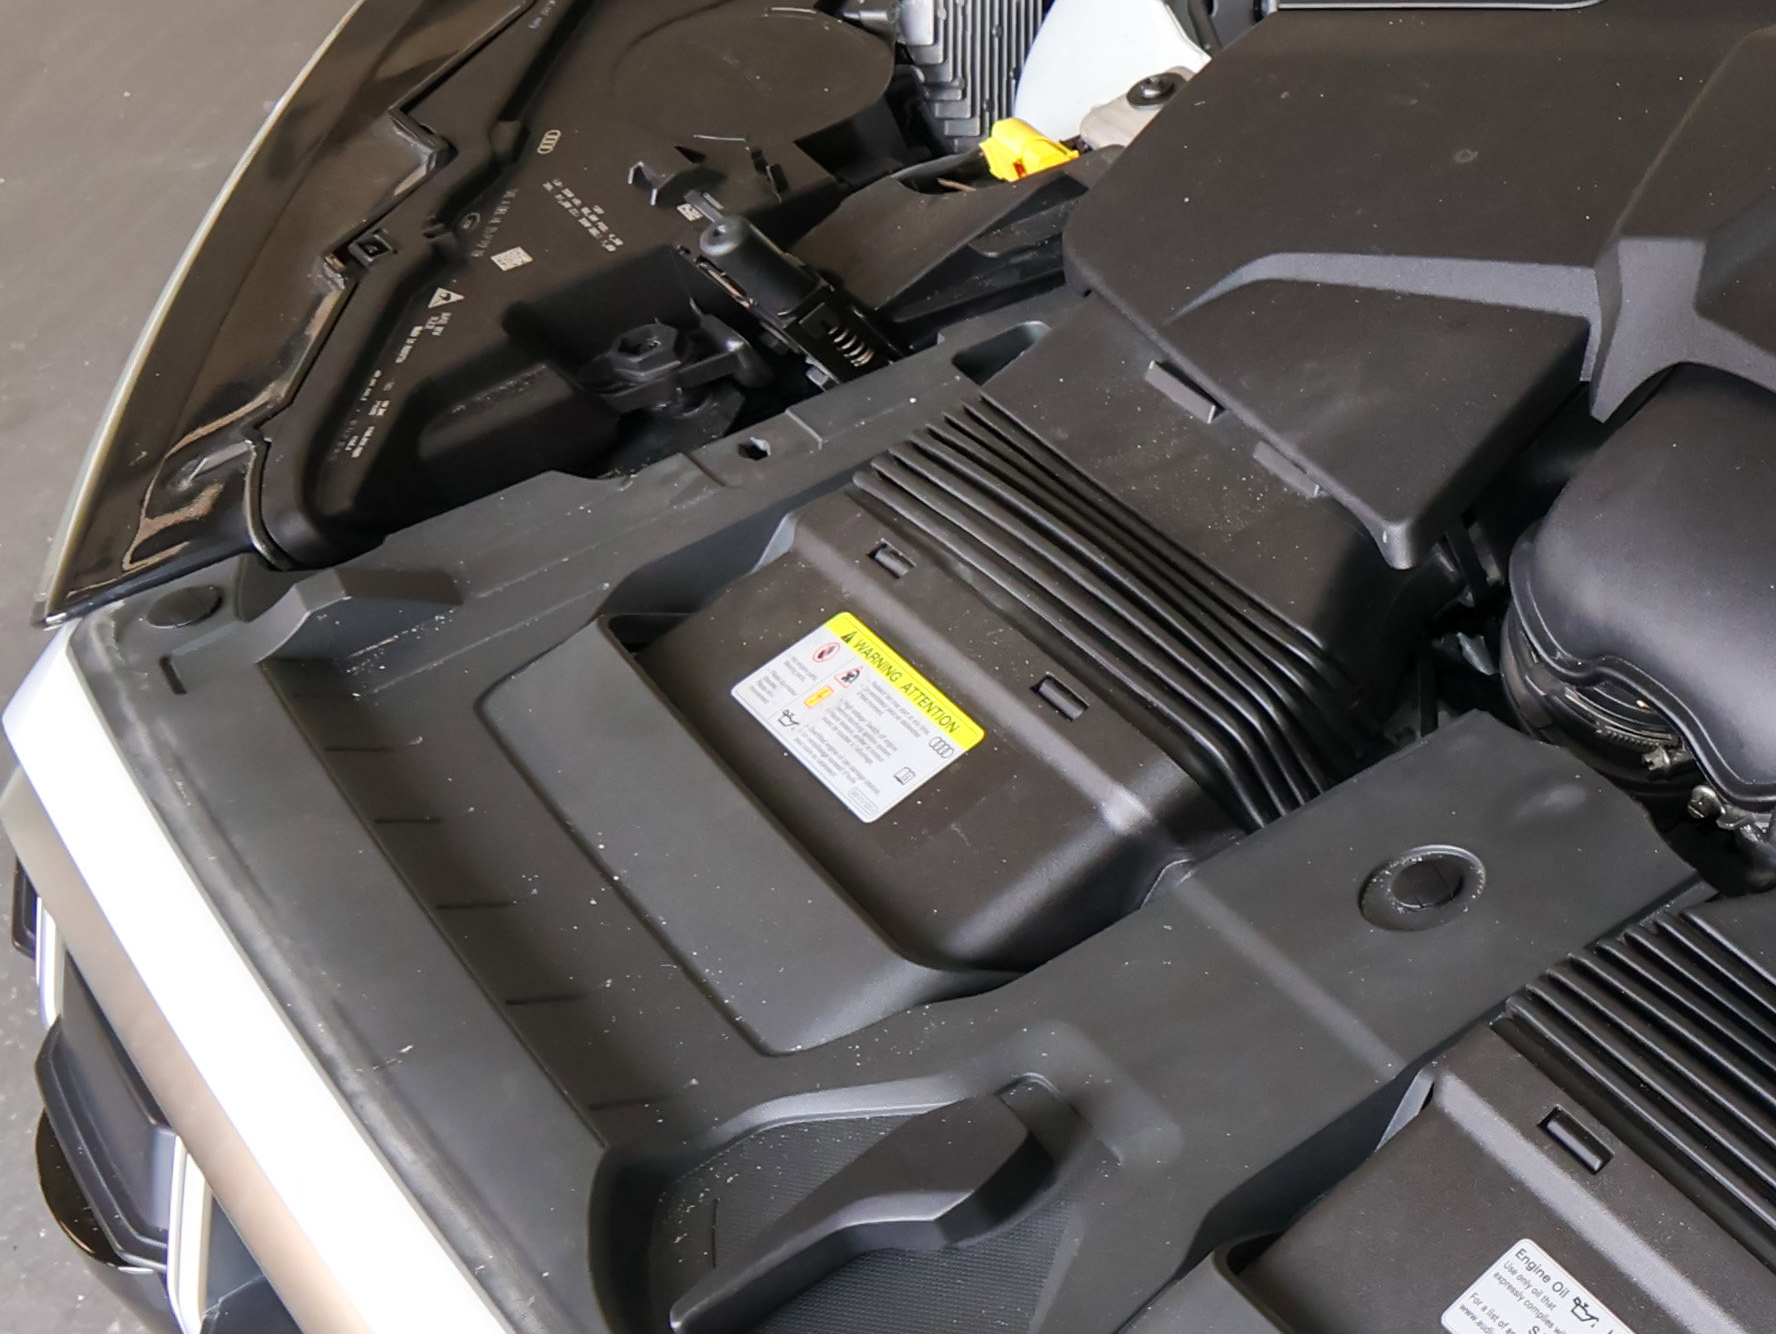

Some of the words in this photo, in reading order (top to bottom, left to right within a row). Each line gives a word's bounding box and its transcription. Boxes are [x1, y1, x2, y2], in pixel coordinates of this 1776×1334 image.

[854, 640, 901, 681] WARNING
[901, 682, 958, 732] ATTENTION
[1503, 1261, 1517, 1275] Use
[1515, 1274, 1531, 1289] only
[1531, 1287, 1542, 1297] oil
[1540, 1296, 1555, 1309] that
[1514, 1249, 1551, 1283] Engine
[1551, 1281, 1568, 1297] Oil
[1469, 1292, 1482, 1304] For
[1486, 1309, 1499, 1321] list
[1498, 1319, 1508, 1329] of
[1492, 1271, 1524, 1301] expressly
[1523, 1299, 1554, 1328] complies
